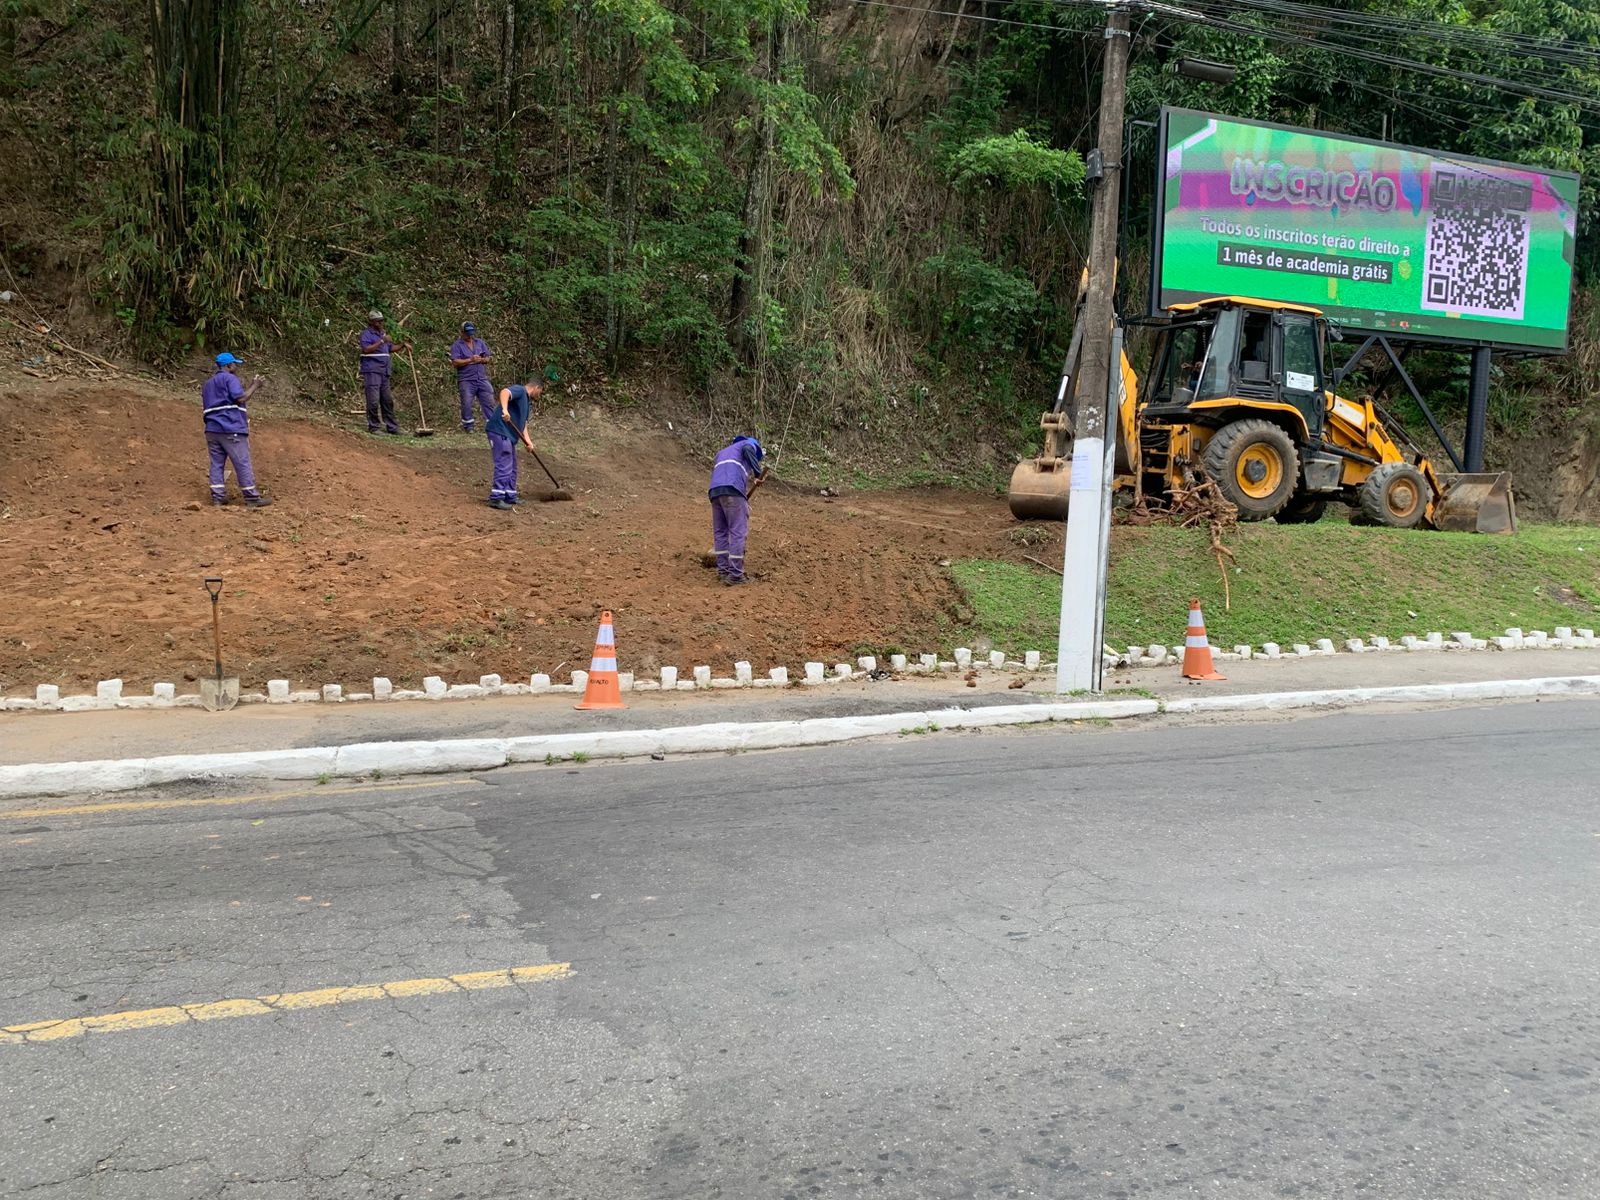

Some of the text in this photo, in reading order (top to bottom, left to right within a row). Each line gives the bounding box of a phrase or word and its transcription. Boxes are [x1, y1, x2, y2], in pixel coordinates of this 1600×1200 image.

[1201, 218, 1410, 257] Todos os inscritos terão direito a
[1223, 248, 1388, 280] 1 mês de academia grátis
